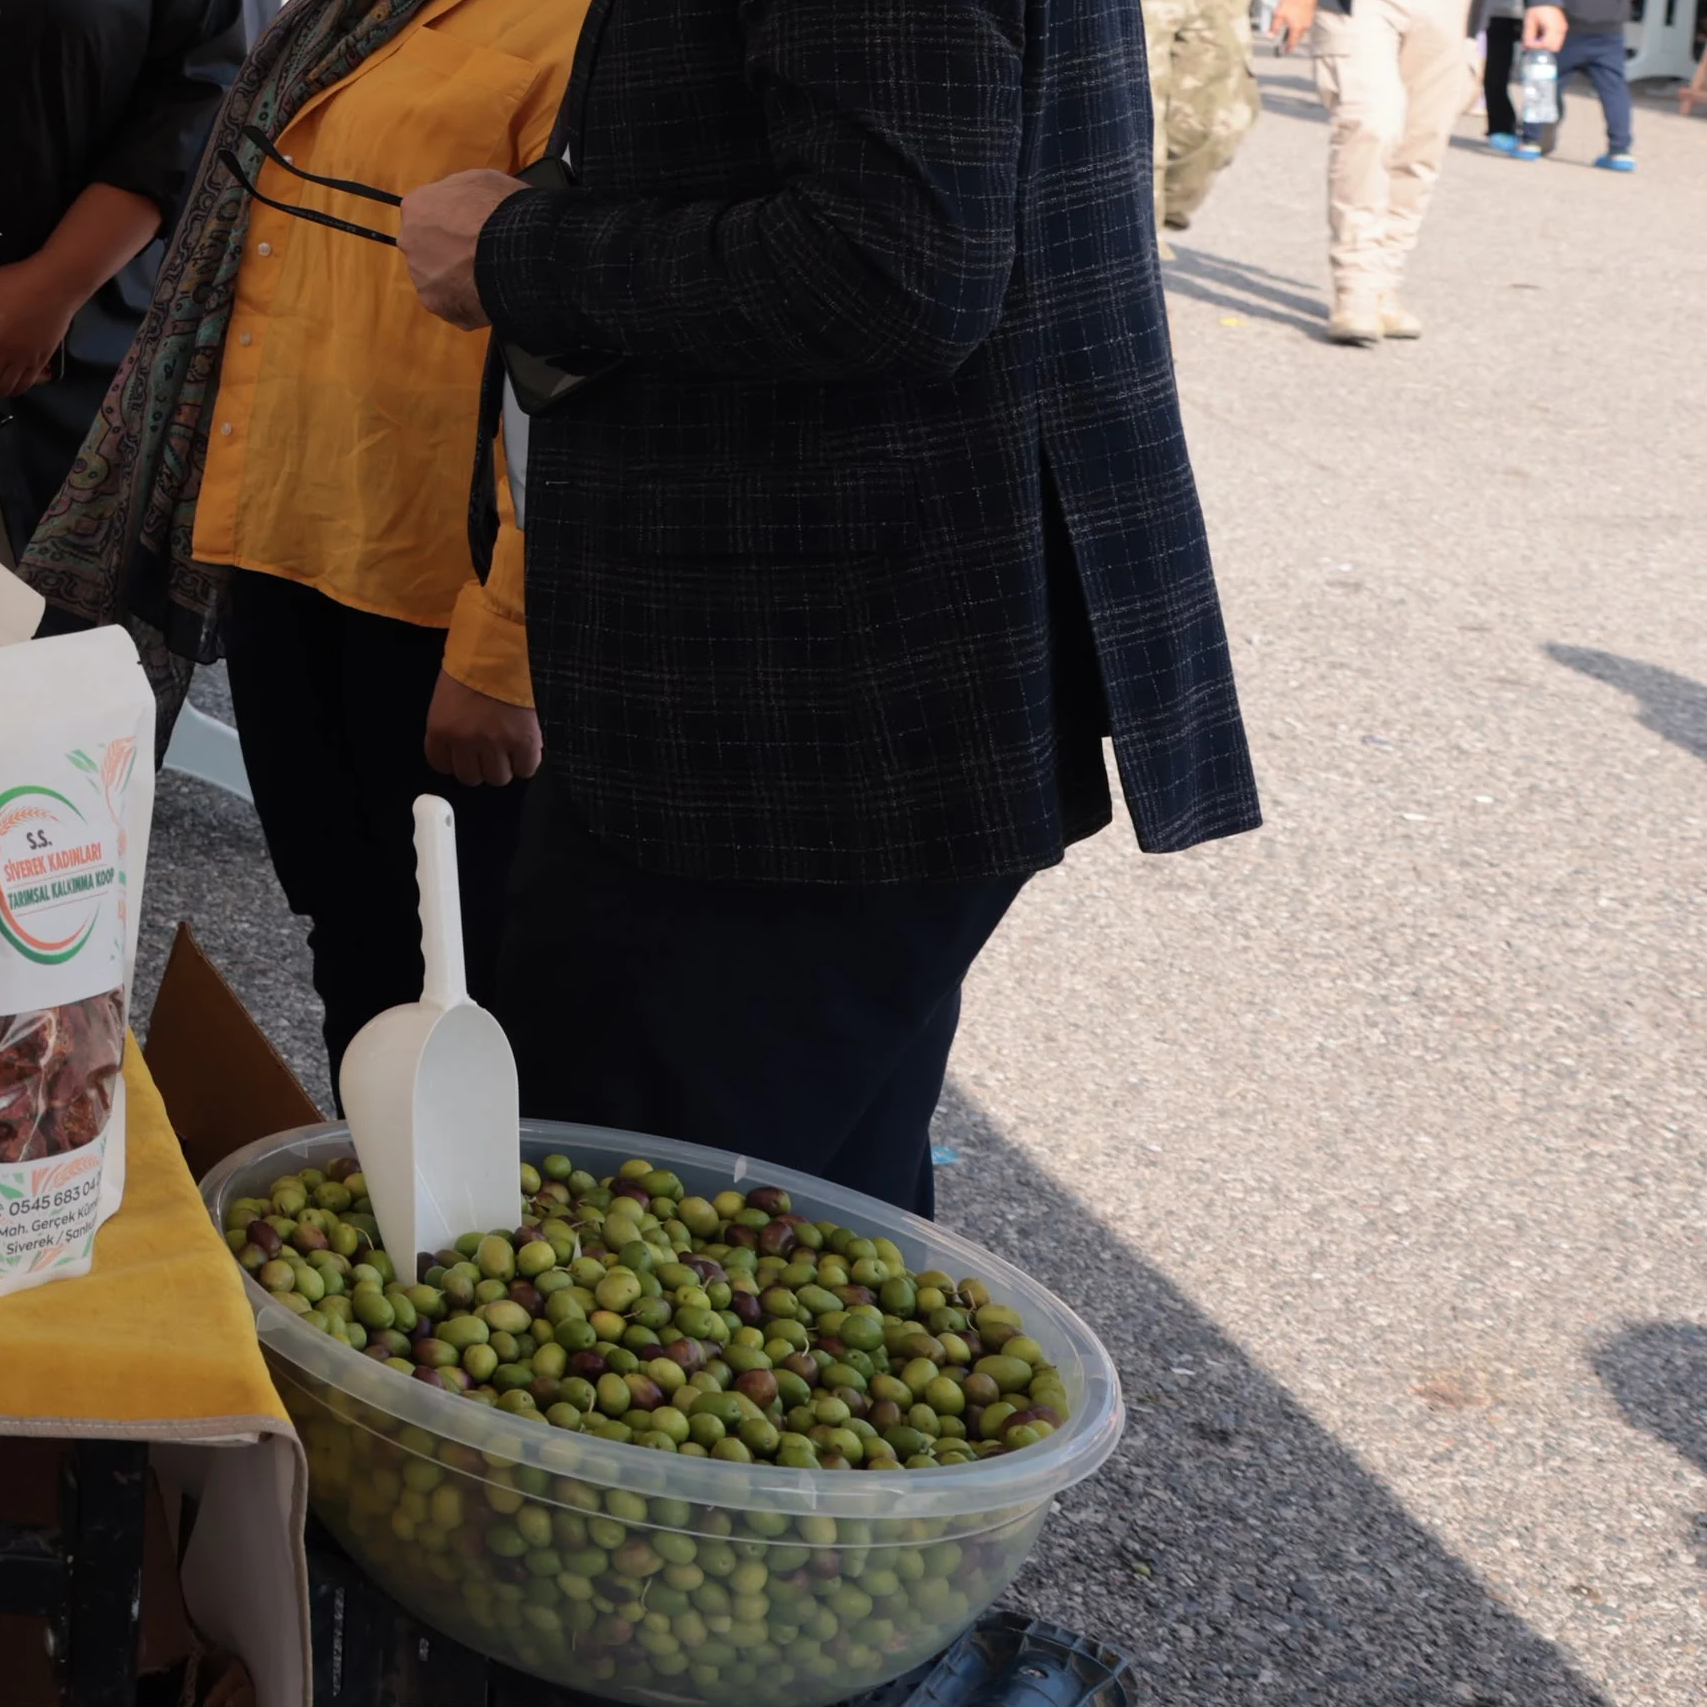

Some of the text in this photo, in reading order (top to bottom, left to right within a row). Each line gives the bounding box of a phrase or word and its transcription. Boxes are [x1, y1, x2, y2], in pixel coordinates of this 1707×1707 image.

[26, 829, 53, 850] S.S.
[3, 842, 102, 882] SİVEREK KADINLARI
[7, 867, 115, 910] TARIMSAL KALKINMA KOOP
[9, 1195, 51, 1216] 0545
[54, 1185, 81, 1207] 683
[31, 1210, 76, 1232] Gerçek
[77, 1197, 98, 1220] Küm
[6, 1236, 54, 1255] Siverek
